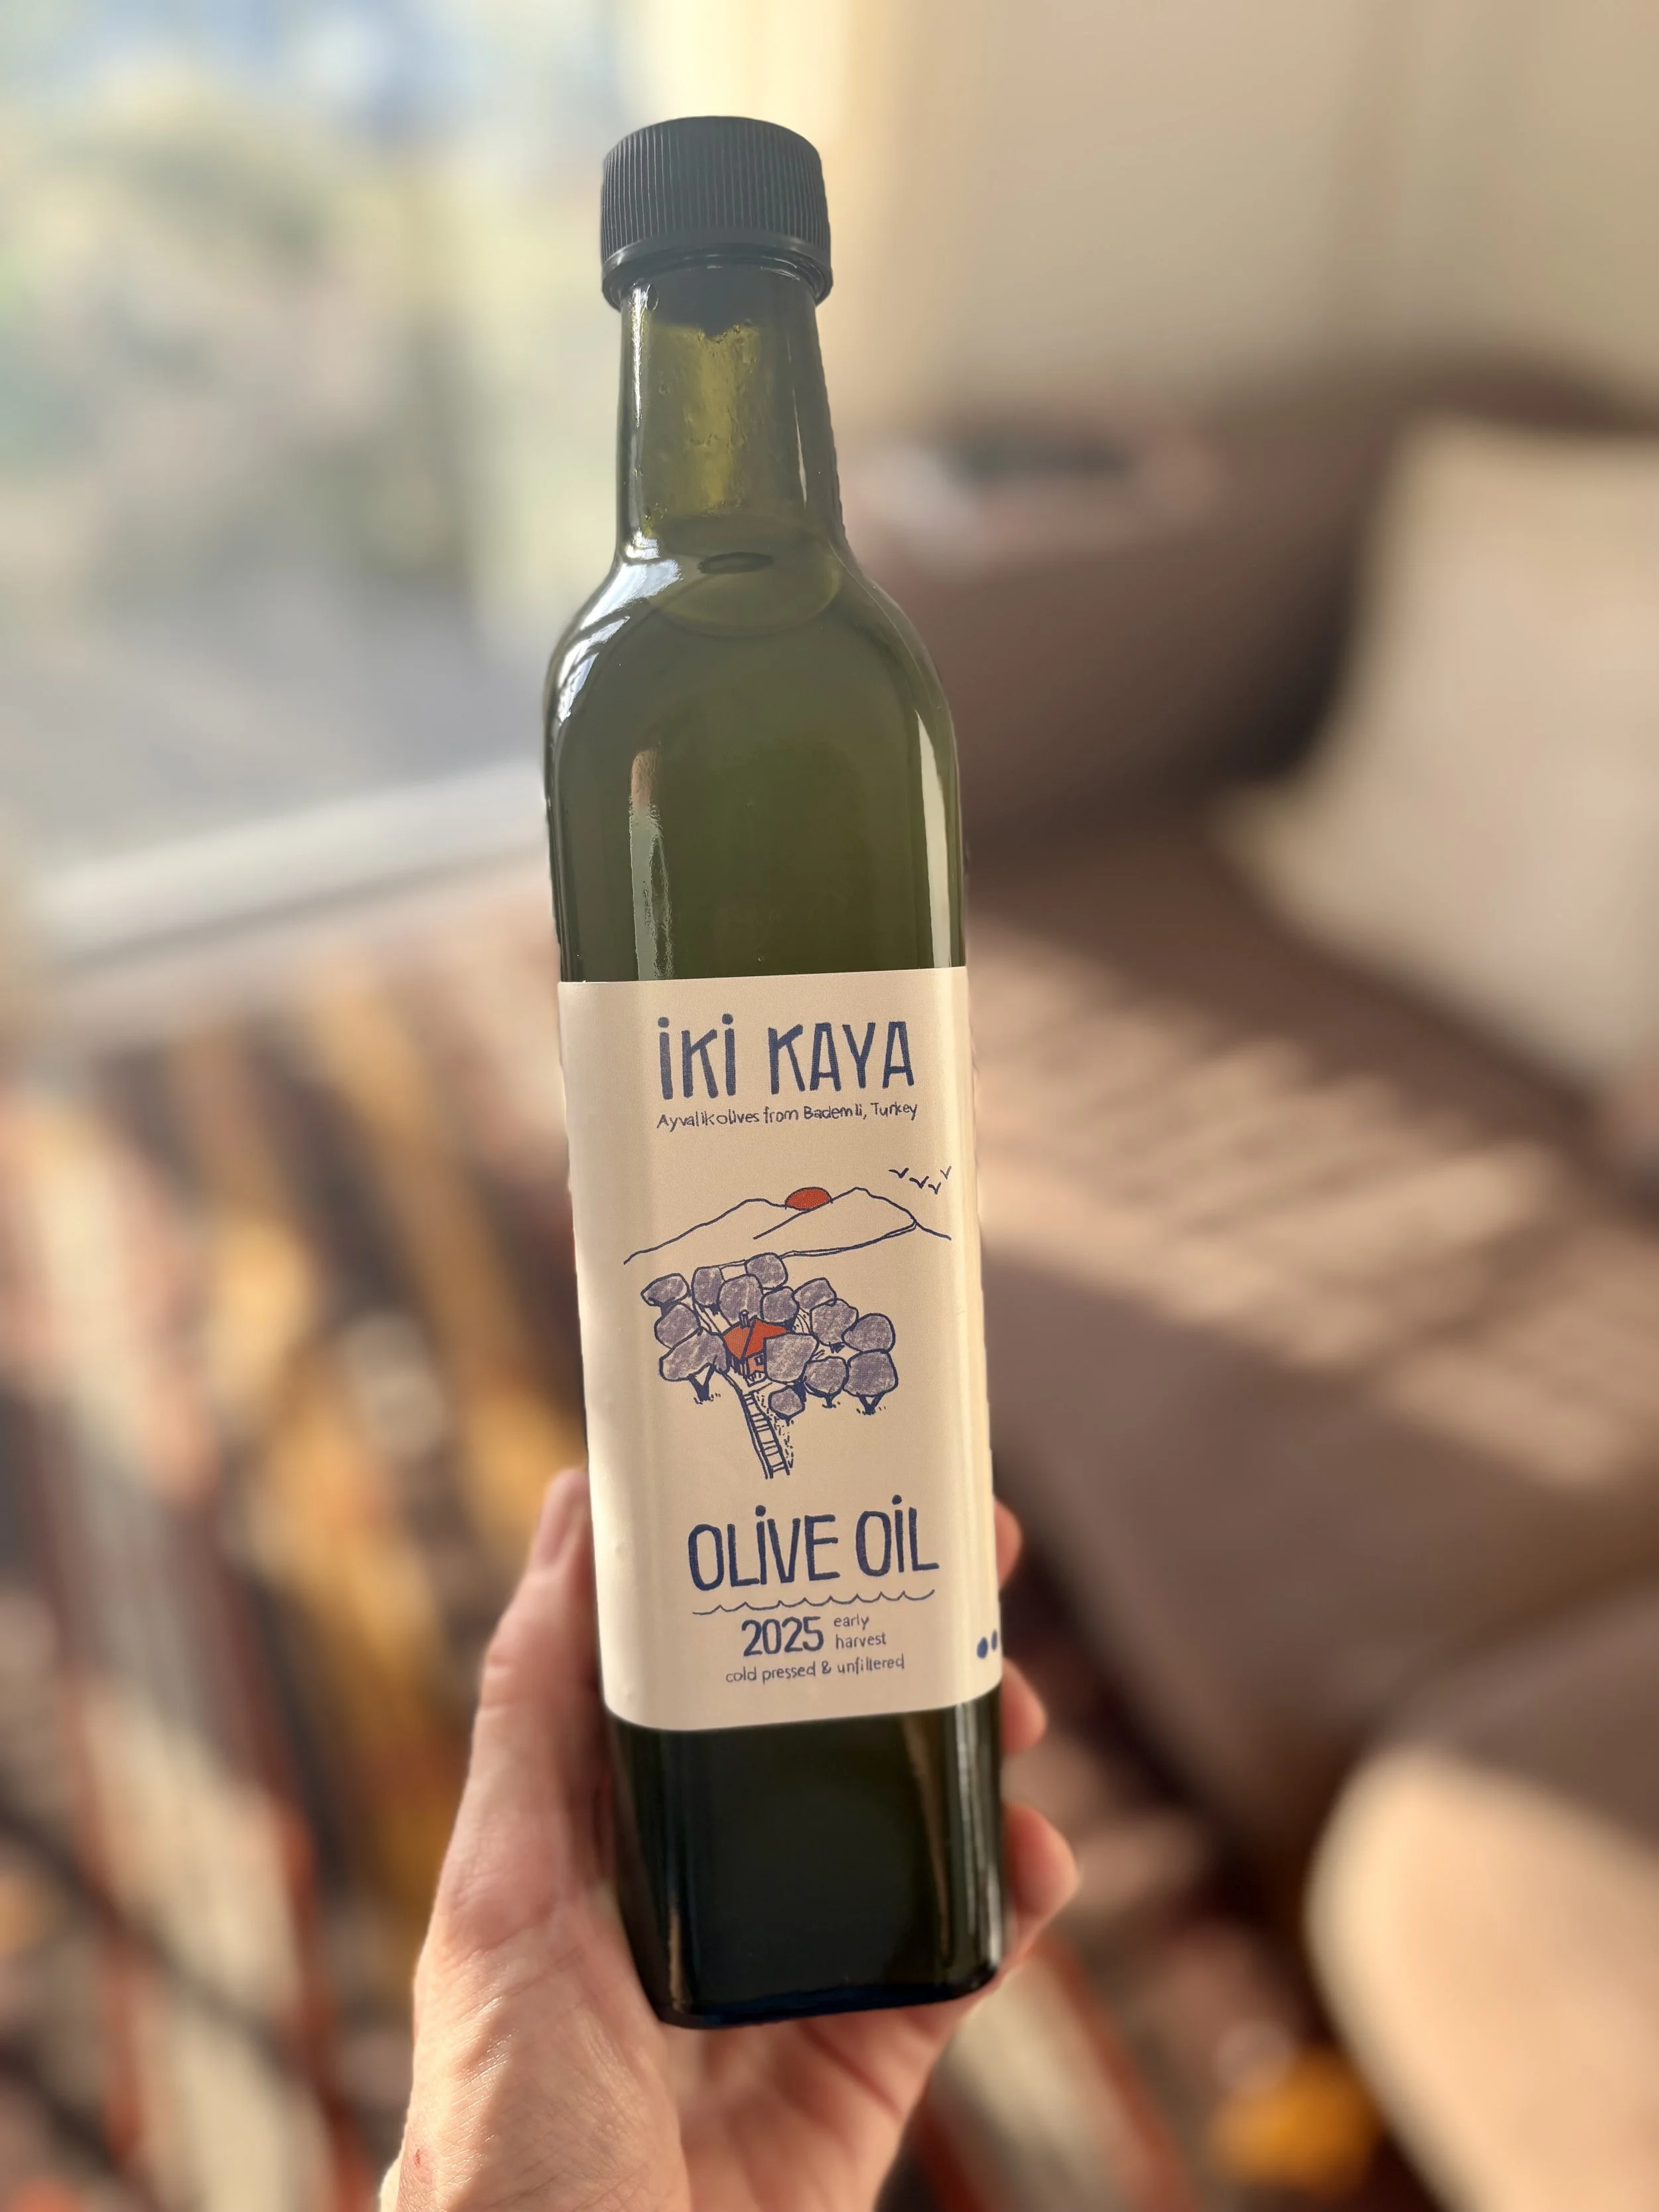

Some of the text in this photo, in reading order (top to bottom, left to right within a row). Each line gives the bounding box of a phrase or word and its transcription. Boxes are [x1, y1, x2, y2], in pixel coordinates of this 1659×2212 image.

[768, 1021, 914, 1095] KAYA
[763, 1106, 799, 1124] from
[804, 1103, 867, 1120] Bademli,
[870, 1102, 918, 1121] Turkey
[833, 1613, 869, 1631] early
[741, 1616, 824, 1657] 2025
[835, 1632, 887, 1649] harvest
[725, 1653, 904, 1684] cold pressed & unfiltered
